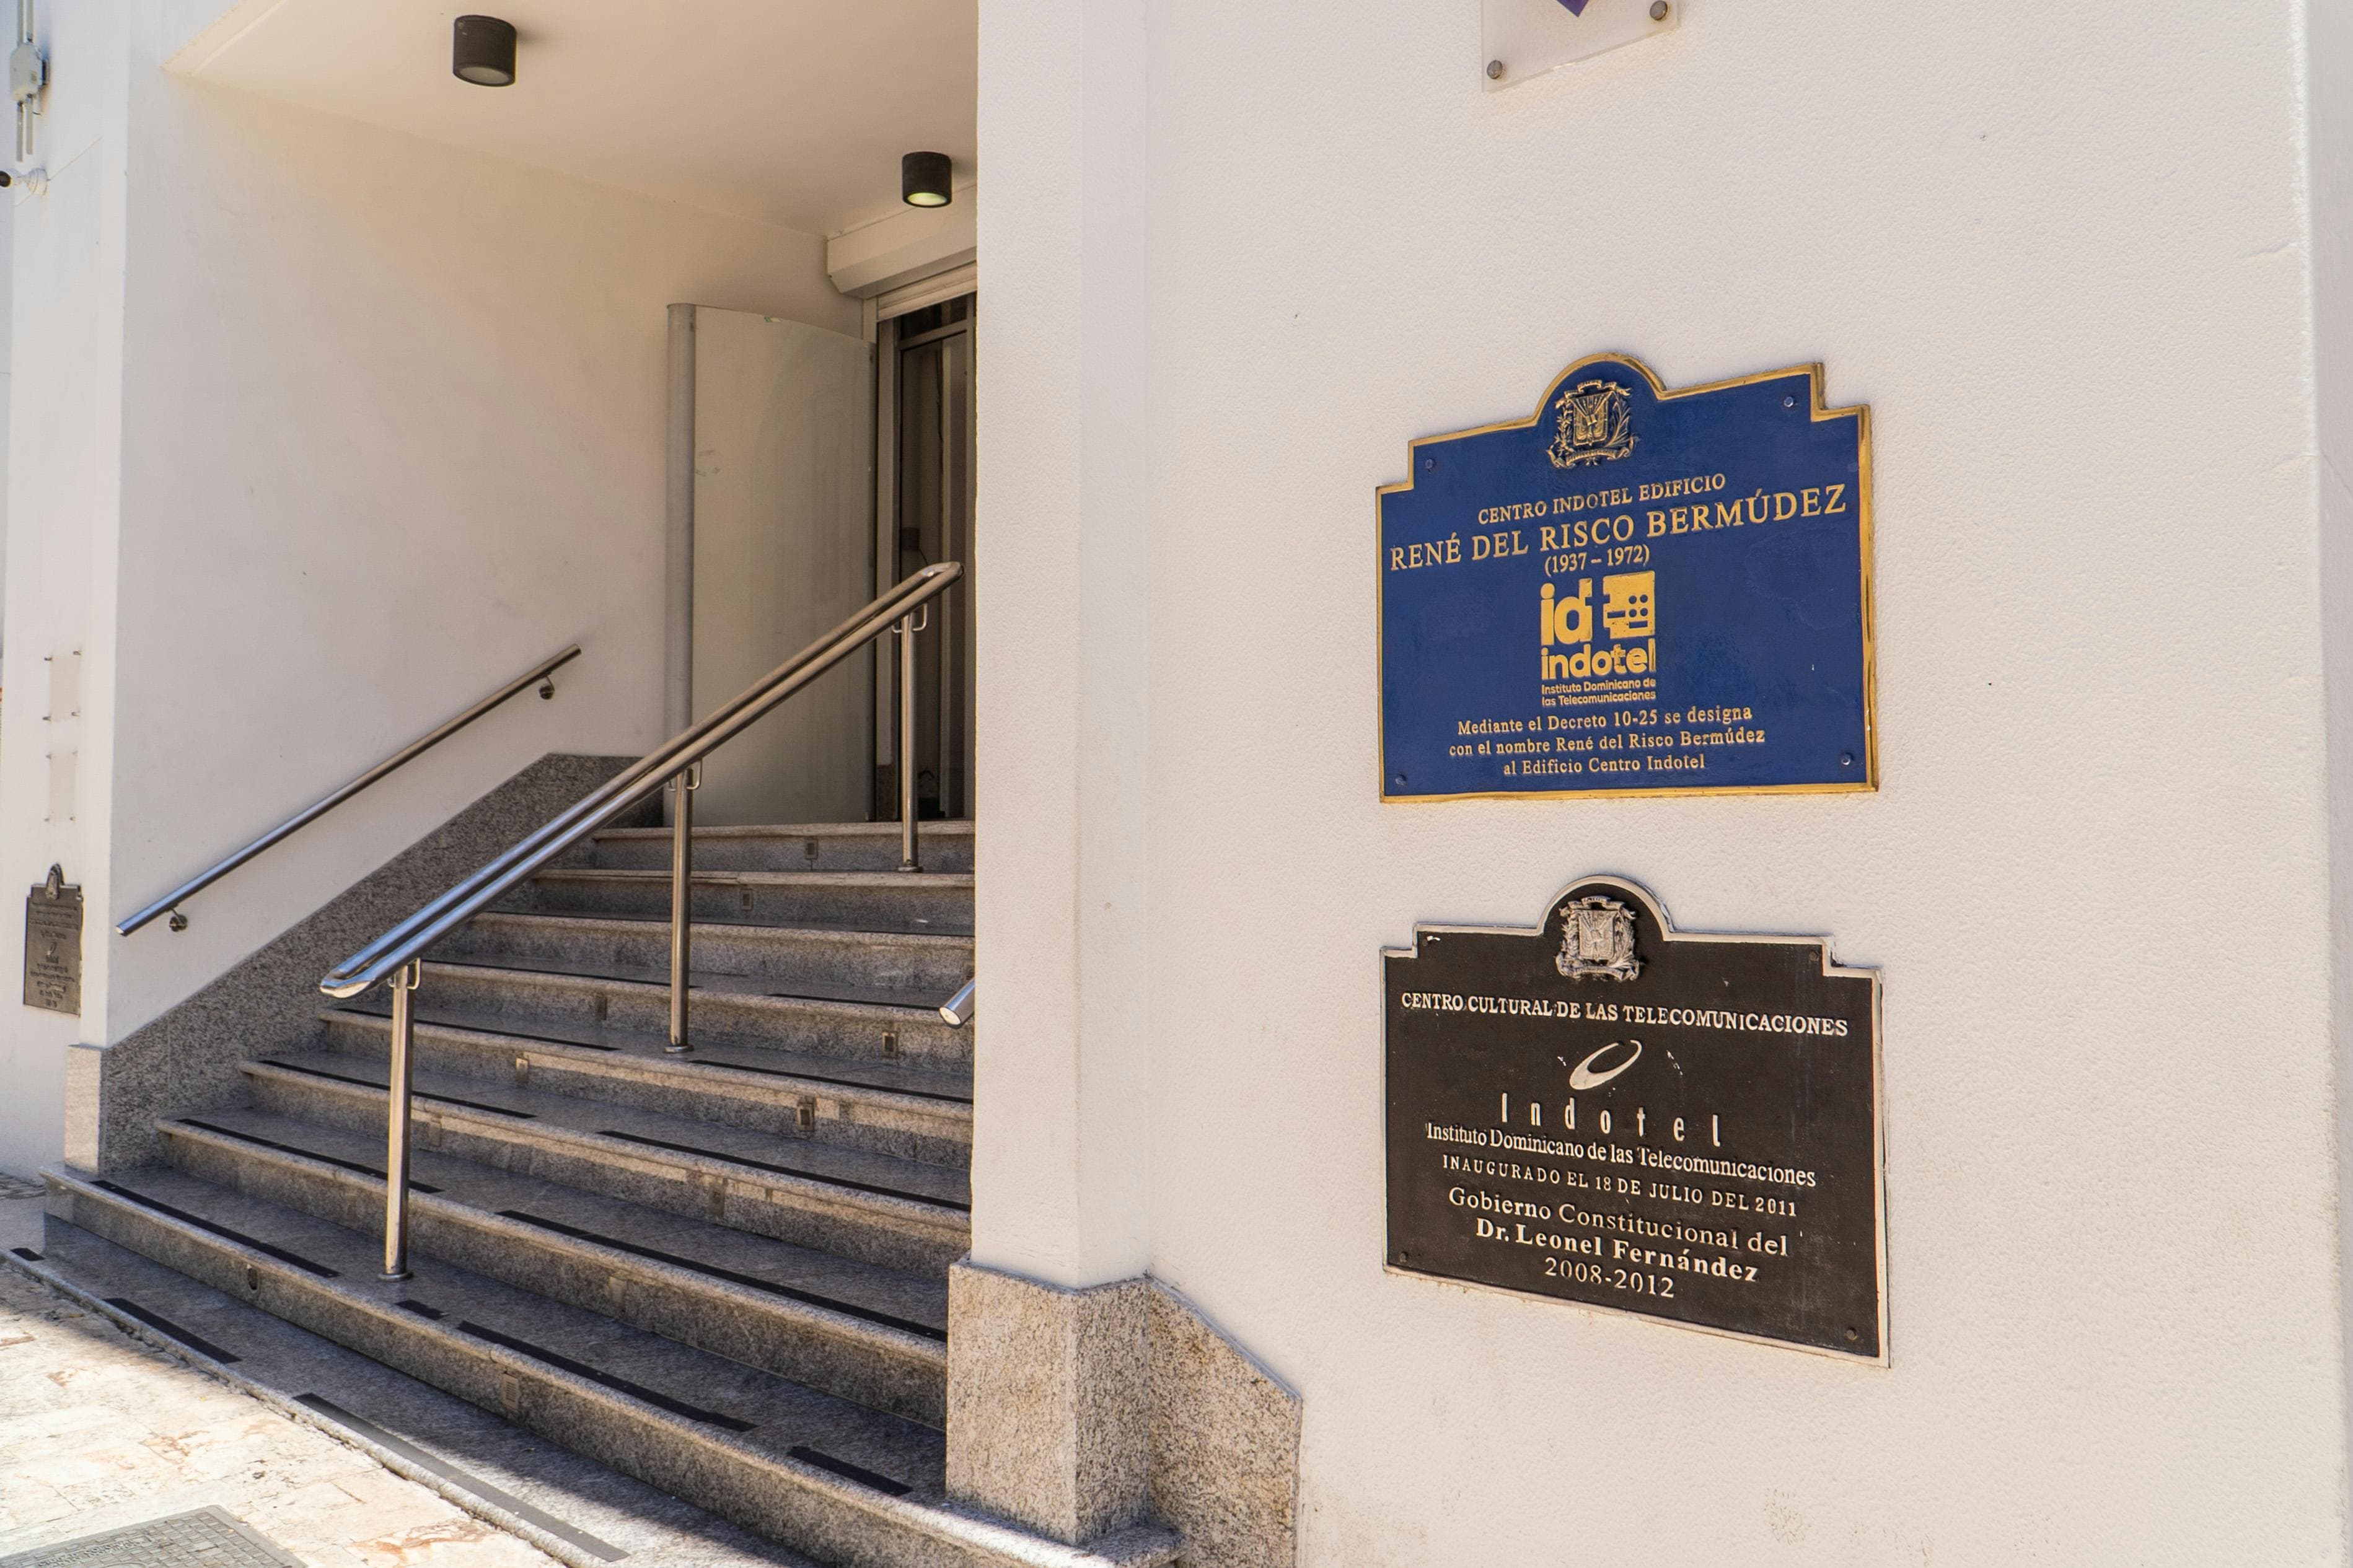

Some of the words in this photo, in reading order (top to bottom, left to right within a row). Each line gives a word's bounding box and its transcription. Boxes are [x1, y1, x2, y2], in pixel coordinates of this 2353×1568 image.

[1478, 501, 1547, 525] CENTRO
[1553, 488, 1632, 515] INDOTEL
[1639, 473, 1726, 501] EDIFICIO
[1390, 532, 1461, 571] RENÉ
[1472, 530, 1529, 561] DEL
[1540, 514, 1634, 552] RISCO
[1647, 483, 1847, 538] BERMÚDEZ
[1541, 638, 1656, 681] indotel
[1541, 683, 1581, 694] Instituto
[1583, 678, 1642, 692] Dominicano
[1643, 677, 1656, 688] de
[1542, 696, 1556, 707] las
[1558, 690, 1656, 706] Telecomunicaciones
[1449, 745, 1473, 756] con
[1478, 740, 1492, 755] el
[1496, 738, 1550, 754] nombre
[1556, 735, 1594, 751] René
[1599, 734, 1624, 750] del
[1629, 732, 1674, 748] Risco
[1680, 726, 1766, 747] Bermúdez
[1458, 718, 1523, 735] Mediante
[1528, 716, 1542, 731] el
[1547, 714, 1607, 730] Decreto
[1614, 709, 1658, 727] 10-25
[1665, 712, 1681, 724] se
[1687, 705, 1753, 724] designa
[1503, 760, 1517, 775] al
[1522, 758, 1583, 774] Edificio
[1588, 757, 1641, 773] Centro
[1647, 753, 1705, 771] Indotel
[1401, 992, 1464, 1011] CENTRO
[1467, 995, 1552, 1017] CULTURAL
[1556, 1001, 1581, 1019] DE
[1585, 1002, 1619, 1022] LAS
[1622, 1004, 1849, 1037] TELECOMUNICACIONES
[1427, 1121, 1487, 1146] Instituto
[1490, 1128, 1584, 1158] Dominicano
[1587, 1141, 1607, 1160] de
[1610, 1144, 1634, 1164] las
[1637, 1146, 1818, 1188] Telecomunicaciones
[1443, 1154, 1560, 1185] INAUGURADO
[1567, 1171, 1589, 1188] EL
[1596, 1176, 1612, 1191] 18
[1617, 1178, 1641, 1196] DE
[1649, 1183, 1704, 1204] JULIO
[1712, 1190, 1749, 1211] DEL
[1754, 1197, 1797, 1217] 2011
[1449, 1186, 1551, 1220] Gobierno
[1559, 1203, 1739, 1250] Constitucional
[1747, 1231, 1788, 1257] del
[1476, 1217, 1510, 1242] Dr.
[1516, 1223, 1603, 1256] Leonel
[1612, 1238, 1759, 1282] Fernández
[1544, 1256, 1674, 1299] 2008-2012
